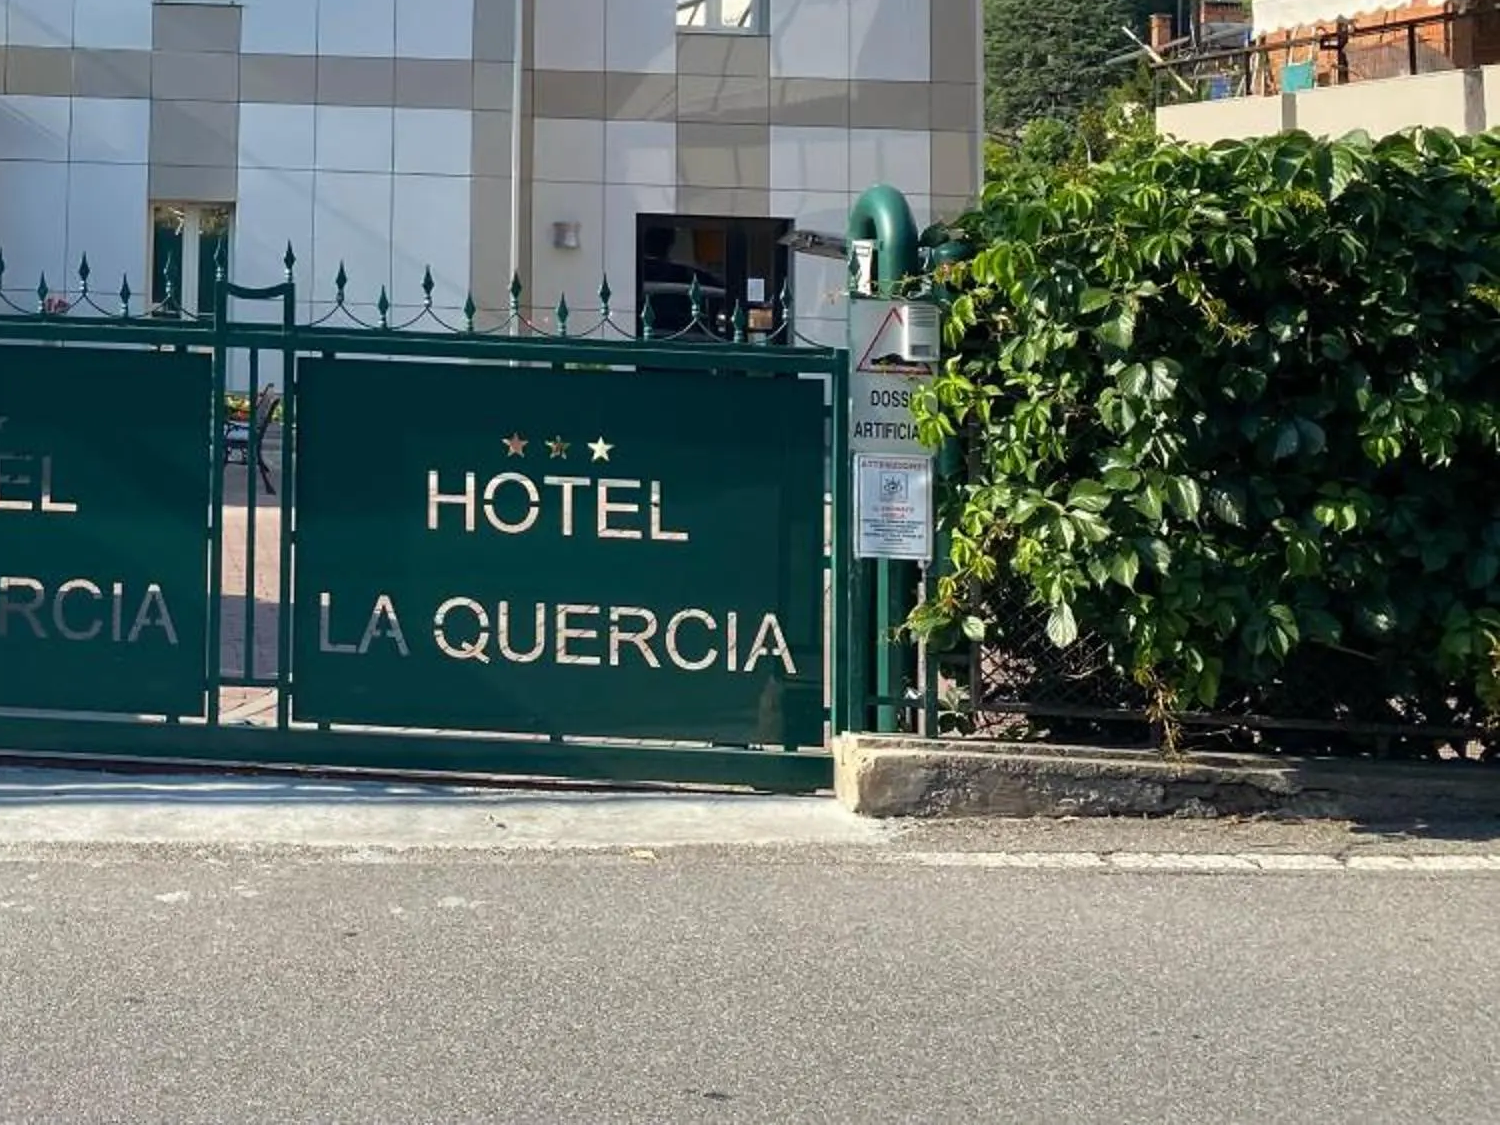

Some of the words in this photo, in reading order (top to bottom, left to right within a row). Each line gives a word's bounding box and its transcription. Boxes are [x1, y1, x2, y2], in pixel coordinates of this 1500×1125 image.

[854, 421, 920, 441] ARTIFICIA
[427, 470, 690, 541] HOTEL
[319, 592, 411, 656] LA
[433, 596, 798, 674] QUERCIA
